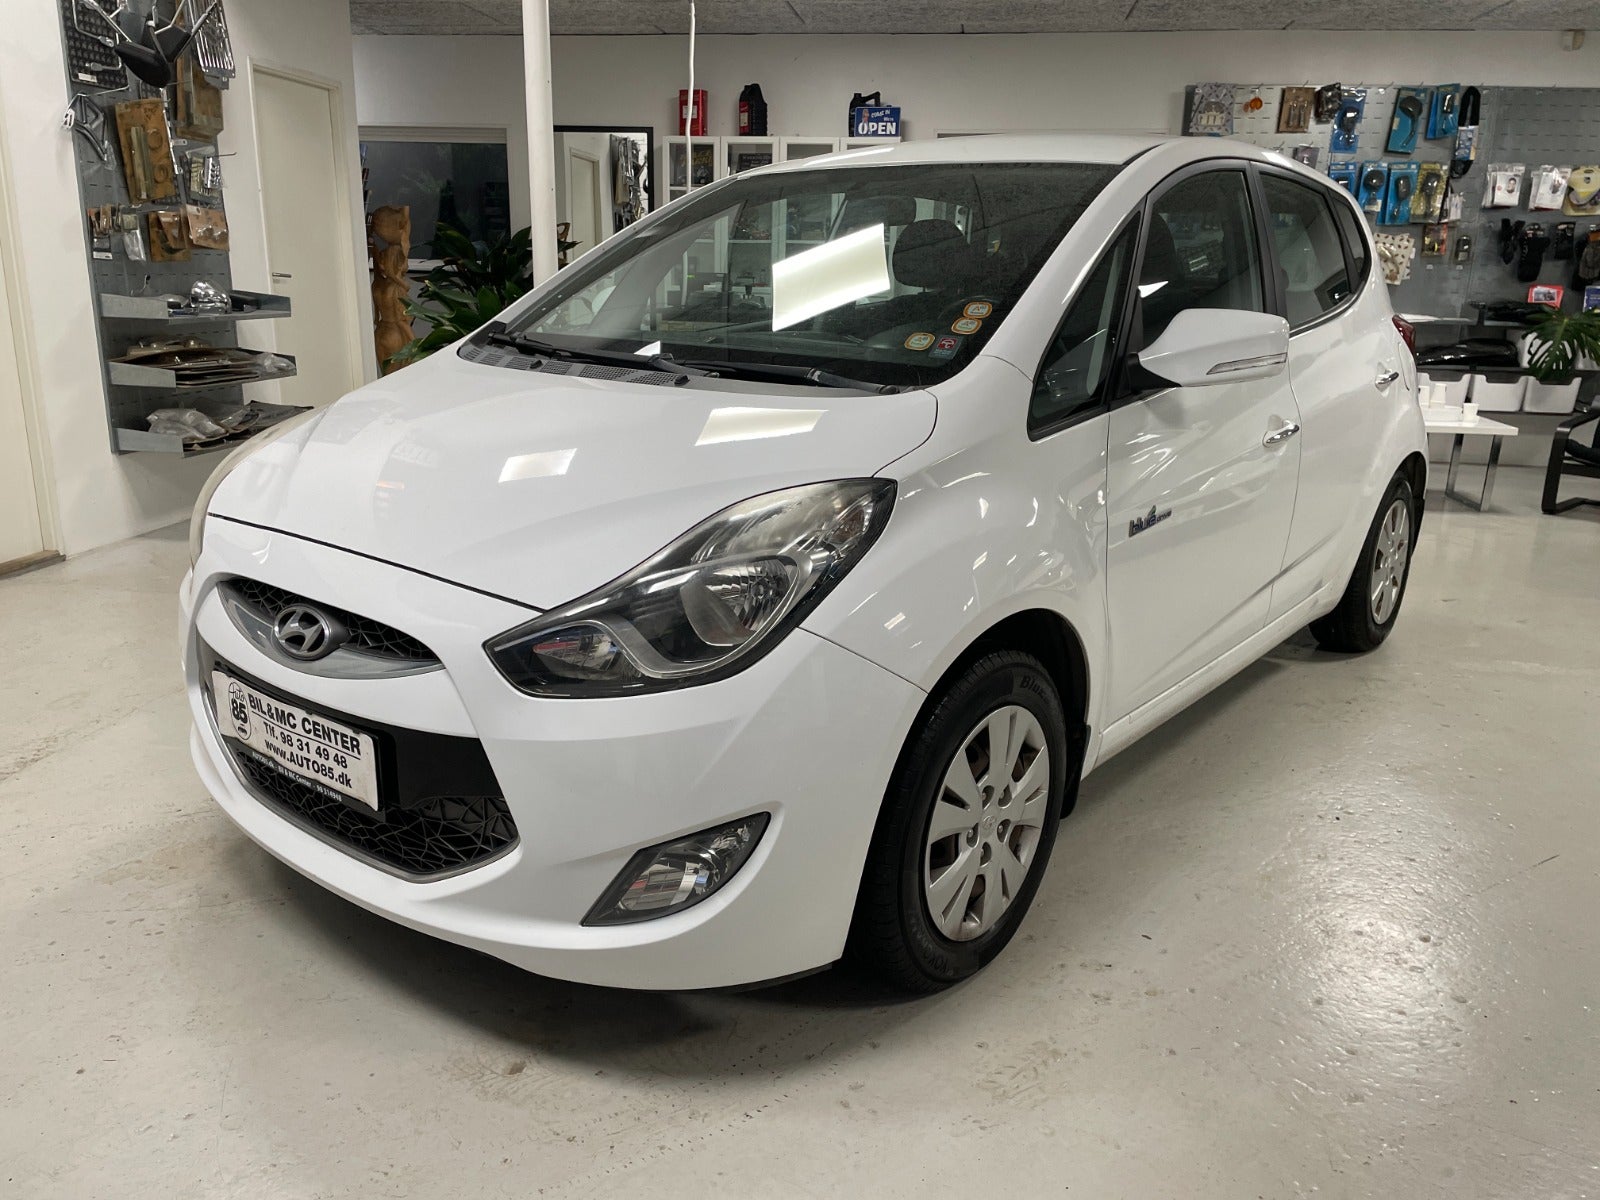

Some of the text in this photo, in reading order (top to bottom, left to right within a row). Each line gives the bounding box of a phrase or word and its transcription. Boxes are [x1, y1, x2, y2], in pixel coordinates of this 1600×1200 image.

[858, 122, 896, 135] OPEN
[231, 698, 248, 724] 85
[247, 692, 361, 757] BIL&MC CENTER
[263, 721, 348, 769] Tlf. 98 31 49 48
[264, 739, 353, 789] www.AUTO85.dk
